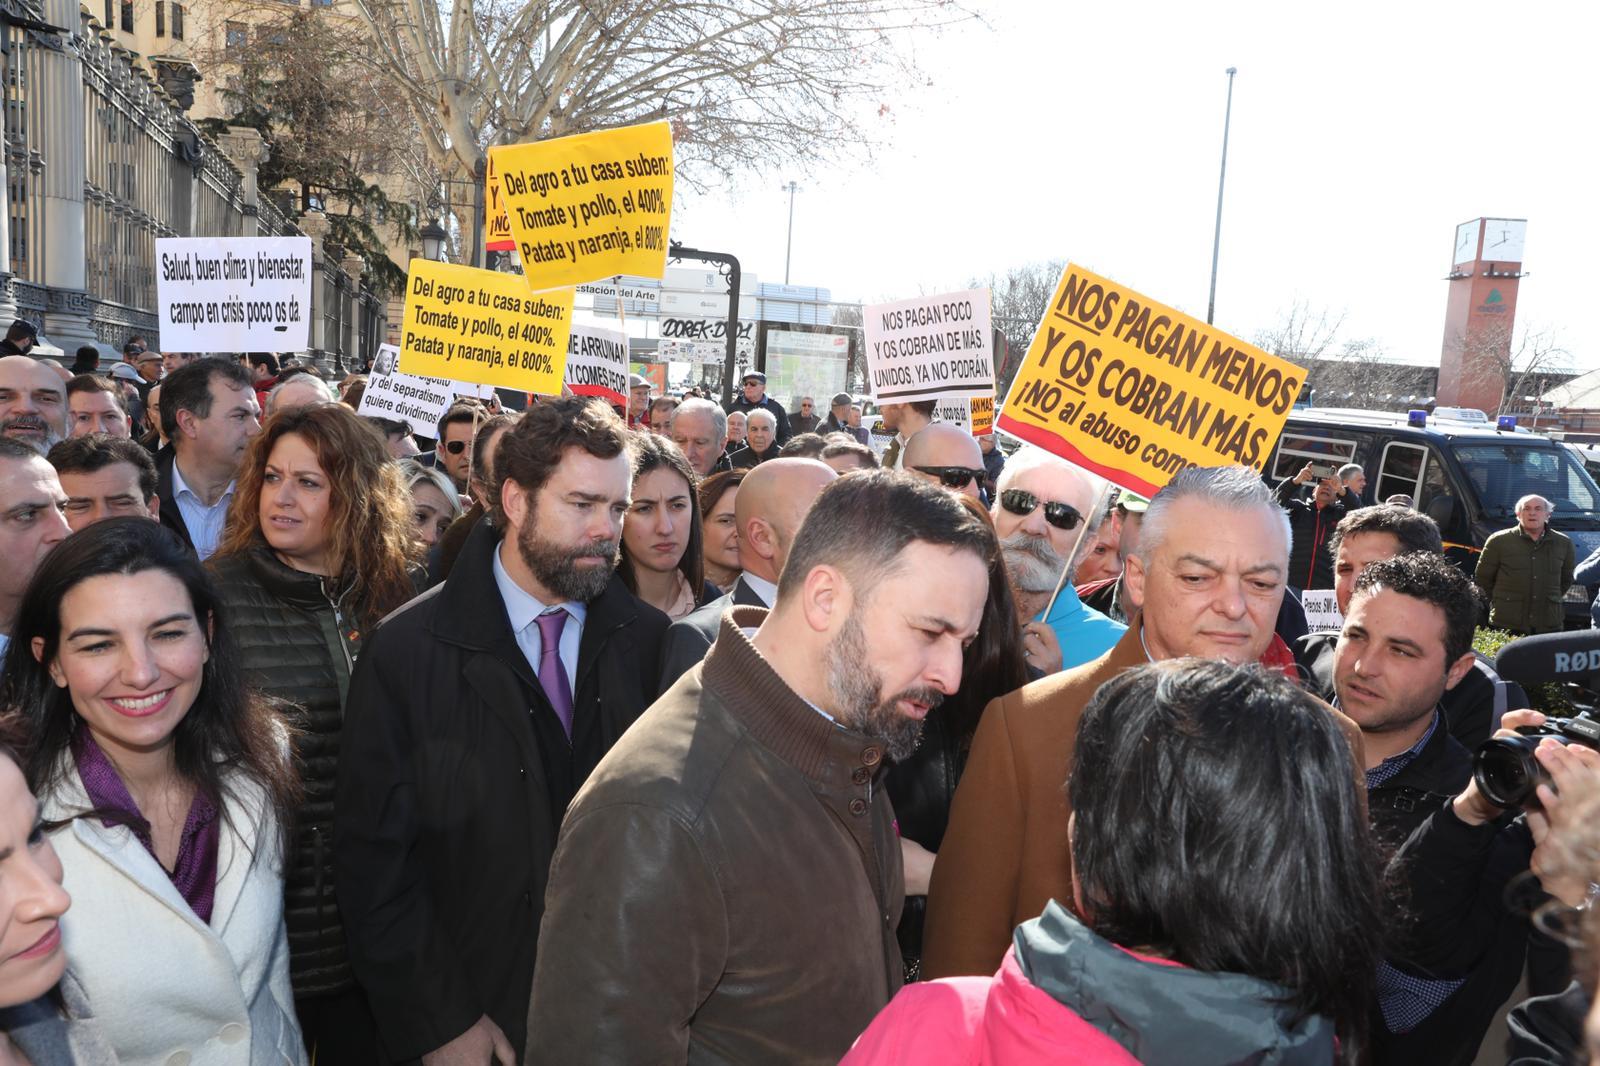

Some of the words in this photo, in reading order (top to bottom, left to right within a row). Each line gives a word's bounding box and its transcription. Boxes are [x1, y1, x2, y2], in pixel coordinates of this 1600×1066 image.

[504, 171, 527, 196] Del
[530, 170, 558, 198] agro
[561, 168, 571, 186] a
[571, 164, 588, 184] tu
[591, 160, 624, 181] casa
[626, 153, 669, 178] suben:
[516, 203, 566, 230] Tomate
[568, 204, 577, 228] y
[580, 193, 622, 226] pollo,
[623, 190, 635, 213] el
[638, 188, 666, 214] 400%.
[522, 238, 566, 264] Patata
[566, 238, 576, 263] y
[578, 226, 634, 256] naranja,
[635, 226, 644, 248] el
[162, 252, 194, 285] Salud,
[195, 253, 220, 280] buen
[223, 252, 247, 280] clima
[250, 258, 255, 287] y
[258, 252, 304, 284] bienestar,
[170, 302, 204, 330] campo
[206, 302, 219, 323] en
[222, 294, 244, 323] crisis
[247, 301, 272, 330] poco
[275, 302, 286, 322] os
[289, 294, 300, 322] da.
[413, 277, 434, 298] Del
[436, 283, 465, 305] agro
[468, 291, 475, 304] a
[479, 288, 490, 307] tu
[493, 294, 520, 312] casa
[524, 298, 564, 320] suben:
[636, 289, 655, 300] Arte
[415, 305, 458, 330] Tomate
[460, 317, 469, 336] y
[472, 318, 504, 340] pollo,
[508, 322, 519, 339] el
[521, 324, 556, 346] 400%.
[882, 311, 903, 332] NOS
[905, 305, 942, 328] PAGAN
[943, 301, 972, 322] POCO
[406, 332, 444, 355] Patata
[446, 342, 455, 361] y
[458, 344, 504, 368] naranja,
[508, 350, 519, 367] el
[521, 352, 553, 374] 800%.
[874, 342, 880, 360] Y
[883, 340, 897, 359] OS
[900, 334, 945, 357] COBRAN
[946, 332, 960, 351] DE
[962, 326, 984, 349] MÁS.
[1056, 274, 1120, 331] NOS
[1113, 299, 1206, 373] PAGAN
[1199, 340, 1298, 415] MENOS
[568, 364, 574, 385] Y
[576, 364, 608, 389] COMES
[874, 366, 914, 387] UNIDOS,
[915, 364, 930, 382] YA
[932, 361, 948, 381] NO
[951, 354, 991, 378] PODRÁN.
[370, 377, 377, 389] y
[378, 376, 393, 390] del
[393, 382, 446, 406] separatismo
[1039, 326, 1066, 368] Y
[1059, 340, 1103, 387] OS
[1098, 359, 1211, 440] COBRAN
[1202, 412, 1268, 469] MÁS.
[365, 395, 393, 411] quiere
[395, 402, 440, 425] dividirnos!
[1012, 379, 1062, 413] ¡NO
[1059, 400, 1081, 426] al
[1080, 412, 1140, 455] abuso
